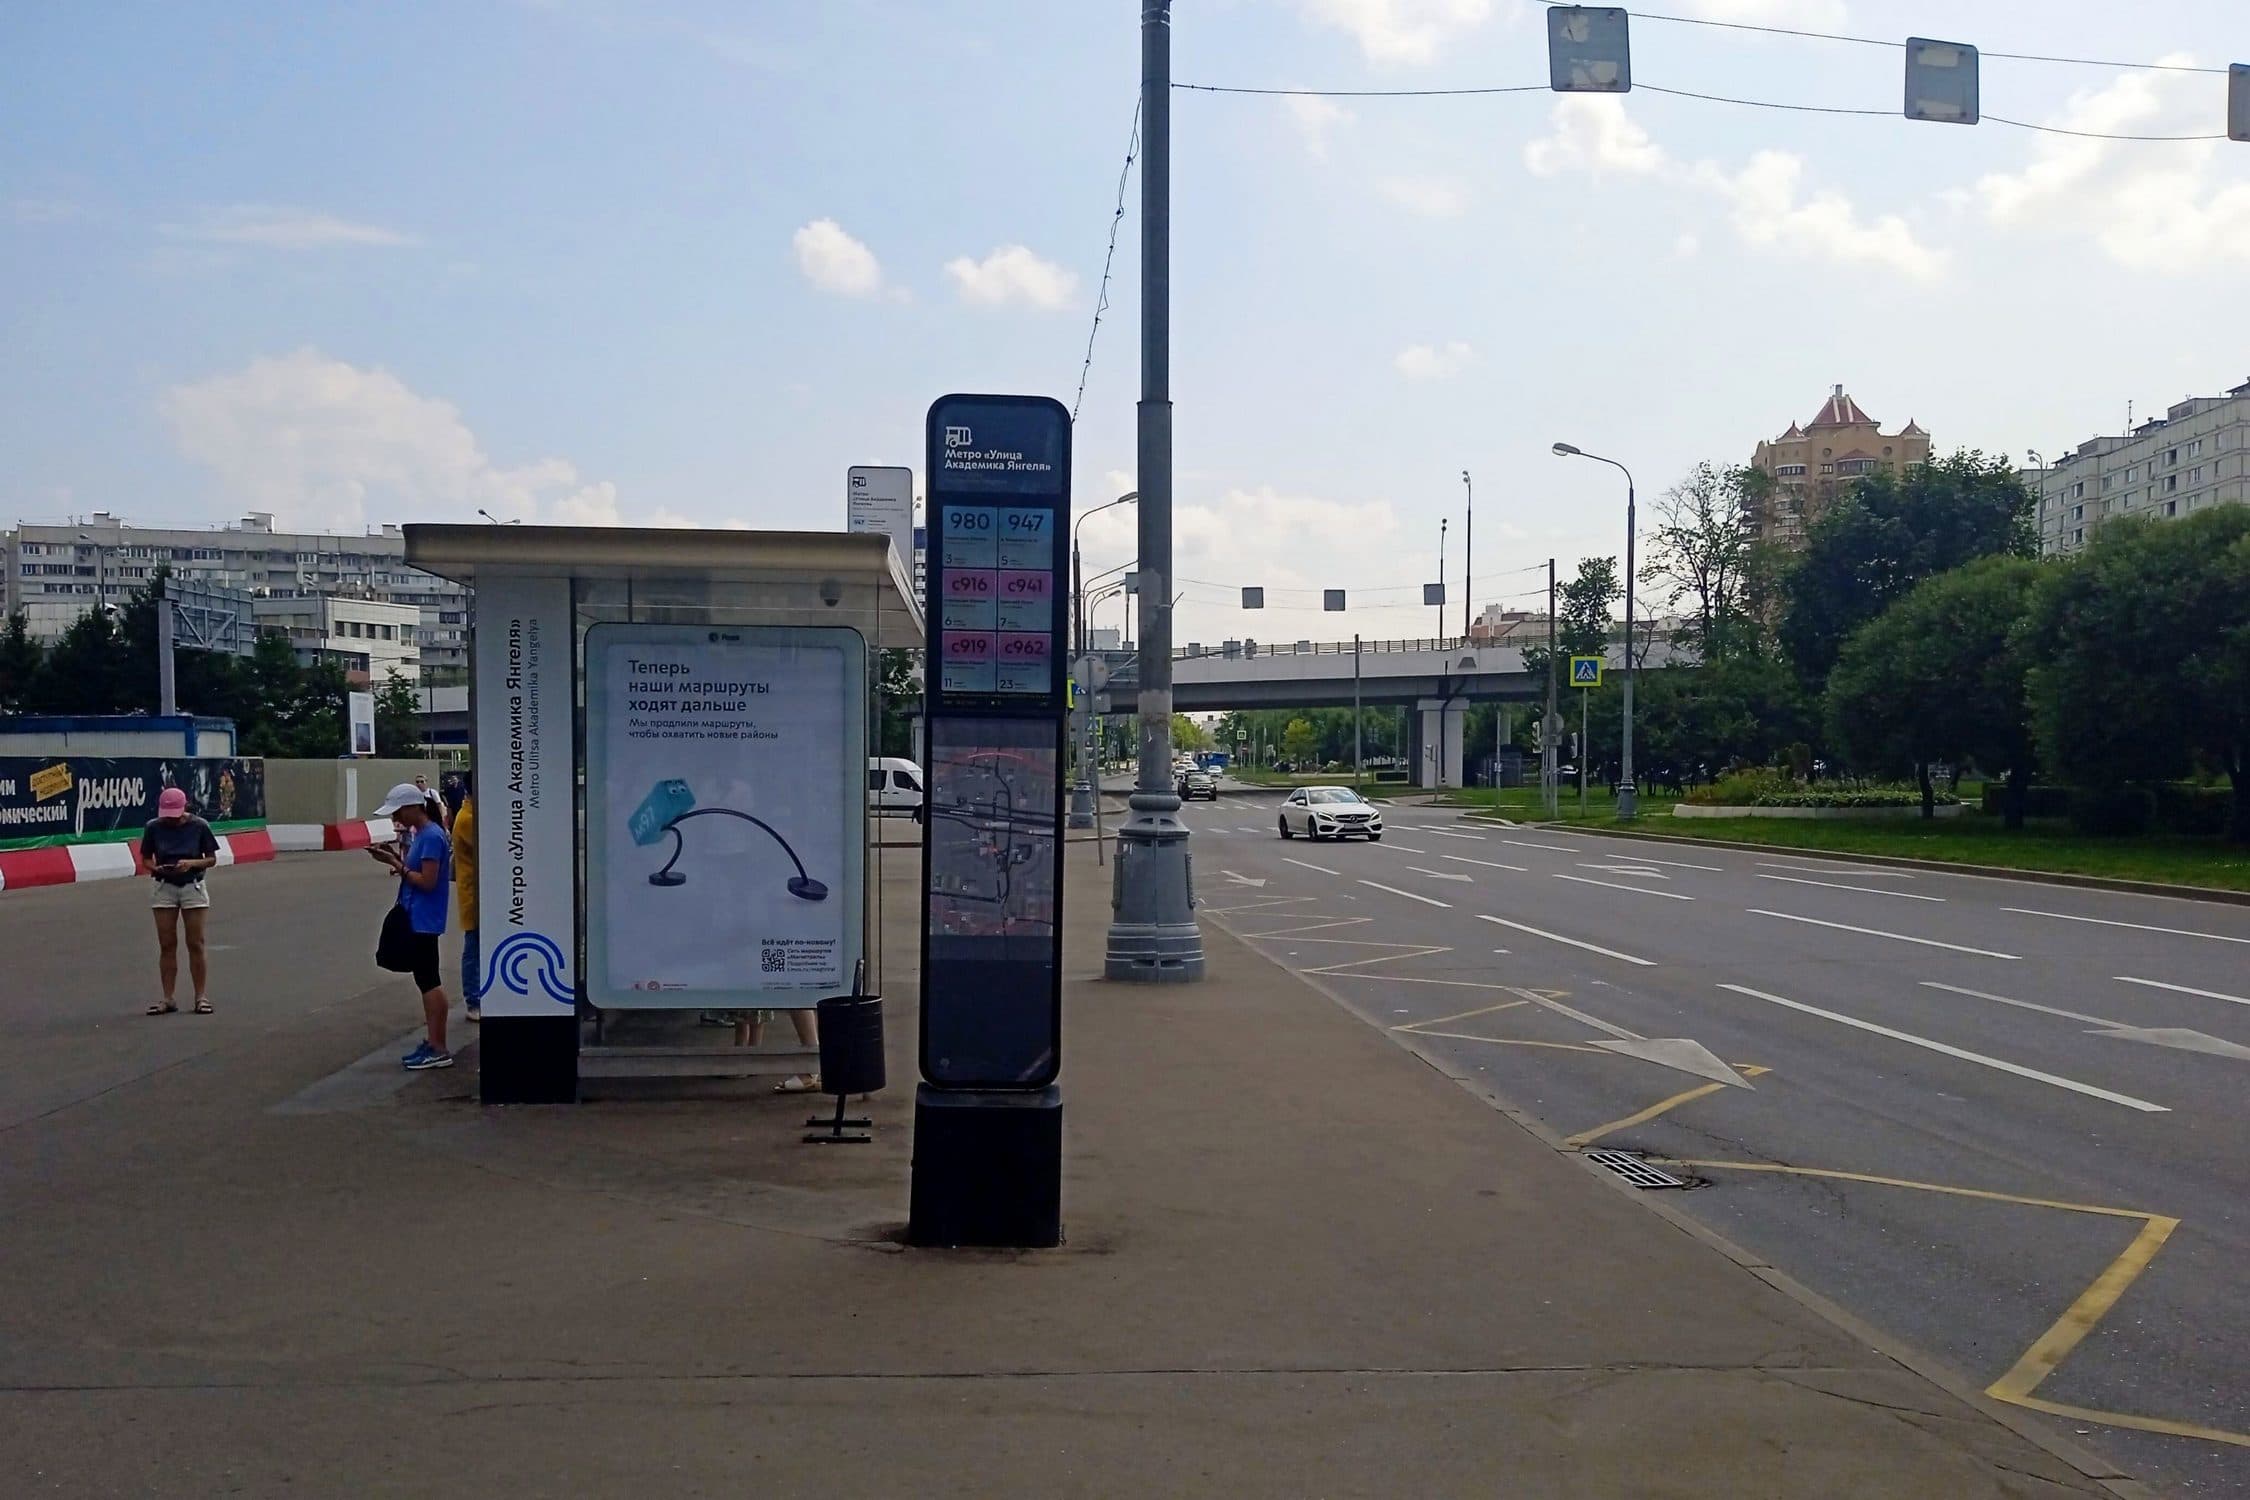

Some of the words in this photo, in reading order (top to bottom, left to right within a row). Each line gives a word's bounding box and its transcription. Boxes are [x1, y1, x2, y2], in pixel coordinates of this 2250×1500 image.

[944, 449, 982, 461] Метро
[984, 450, 1023, 461] «Улица
[944, 460, 1005, 471] Академика
[1007, 461, 1051, 472] Янгеля»
[950, 512, 990, 530] 980
[1008, 514, 1044, 532] 947
[1001, 556, 1009, 566] 5
[944, 617, 952, 626] 6
[1000, 618, 1007, 627] 7
[527, 619, 541, 670] Yangelya
[506, 619, 522, 690] Янгеля»
[628, 660, 690, 677] Теперь
[628, 682, 674, 693] наши
[678, 681, 770, 696] маршруты
[944, 678, 952, 688] 11
[1000, 680, 1014, 690] 23
[528, 672, 539, 736] Akademika
[628, 700, 678, 713] ходят
[680, 700, 747, 713] дальше
[628, 718, 648, 728] Мы
[650, 719, 699, 730] продлили
[701, 720, 756, 731] маршруты,
[628, 729, 660, 739] чтобы
[661, 730, 705, 739] охватить
[706, 731, 738, 740] новые
[740, 730, 779, 741] районы
[507, 696, 525, 794] Академика
[528, 739, 539, 771] Ulitsa
[529, 773, 540, 809] Metro
[75, 777, 146, 838] рынок
[507, 800, 526, 861] «Улица
[508, 865, 527, 926] Метро
